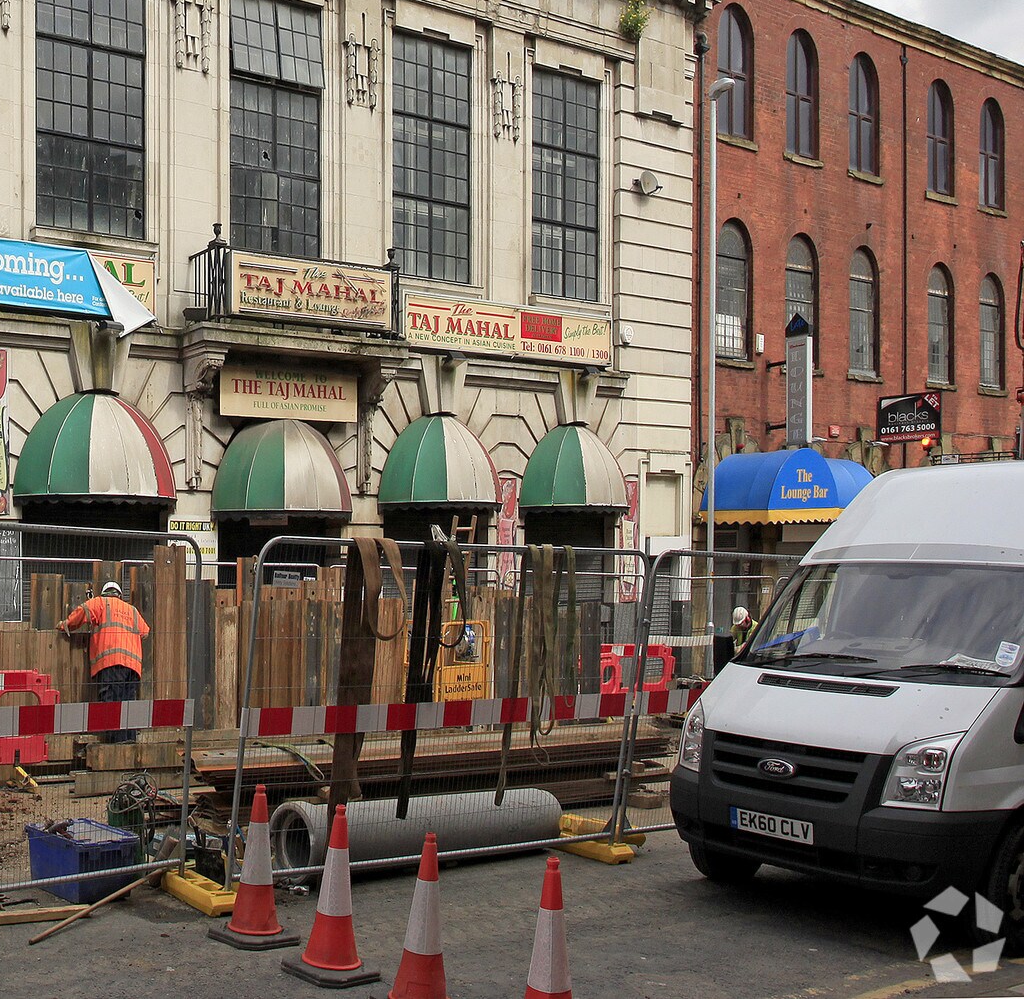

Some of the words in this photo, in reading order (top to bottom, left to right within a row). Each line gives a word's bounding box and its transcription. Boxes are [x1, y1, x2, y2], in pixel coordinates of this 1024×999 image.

[302, 266, 327, 280] The
[240, 272, 285, 297] TAJ
[291, 279, 386, 306] MAHAL
[57, 289, 84, 304] here
[451, 303, 474, 316] The
[407, 312, 441, 335] TAJ
[445, 316, 515, 341] MAHAL
[432, 335, 462, 344] CONCEPT
[472, 339, 491, 348] ASIAN
[492, 341, 516, 350] CUISINE
[521, 341, 535, 352] Tel:
[537, 343, 552, 354] 0161
[554, 345, 567, 355] 678
[569, 346, 585, 358] 1100
[592, 349, 609, 360] 1300
[256, 369, 307, 382] WELCOME
[314, 373, 327, 383] TO
[231, 378, 263, 395] THE
[266, 380, 291, 401] TAJ
[293, 383, 347, 401] MAHAL
[253, 401, 270, 409] FULL
[270, 401, 280, 410] OF
[279, 402, 300, 410] ASIAN
[299, 403, 327, 412] PROMISE
[924, 393, 940, 408] LET
[887, 402, 929, 423] blacks
[881, 426, 899, 434] 0161
[901, 425, 915, 433] 763
[916, 423, 936, 431] 5000
[797, 468, 813, 482] The
[781, 485, 812, 502] Lounge
[813, 484, 828, 499] Bar
[170, 521, 179, 530] DO
[179, 522, 185, 530] IT
[186, 522, 202, 531] RIGHT
[456, 673, 472, 682] Mini
[445, 682, 482, 693] LadderSafe
[764, 760, 785, 773] Ford
[739, 810, 776, 833] EK60
[781, 819, 810, 840] CLV
